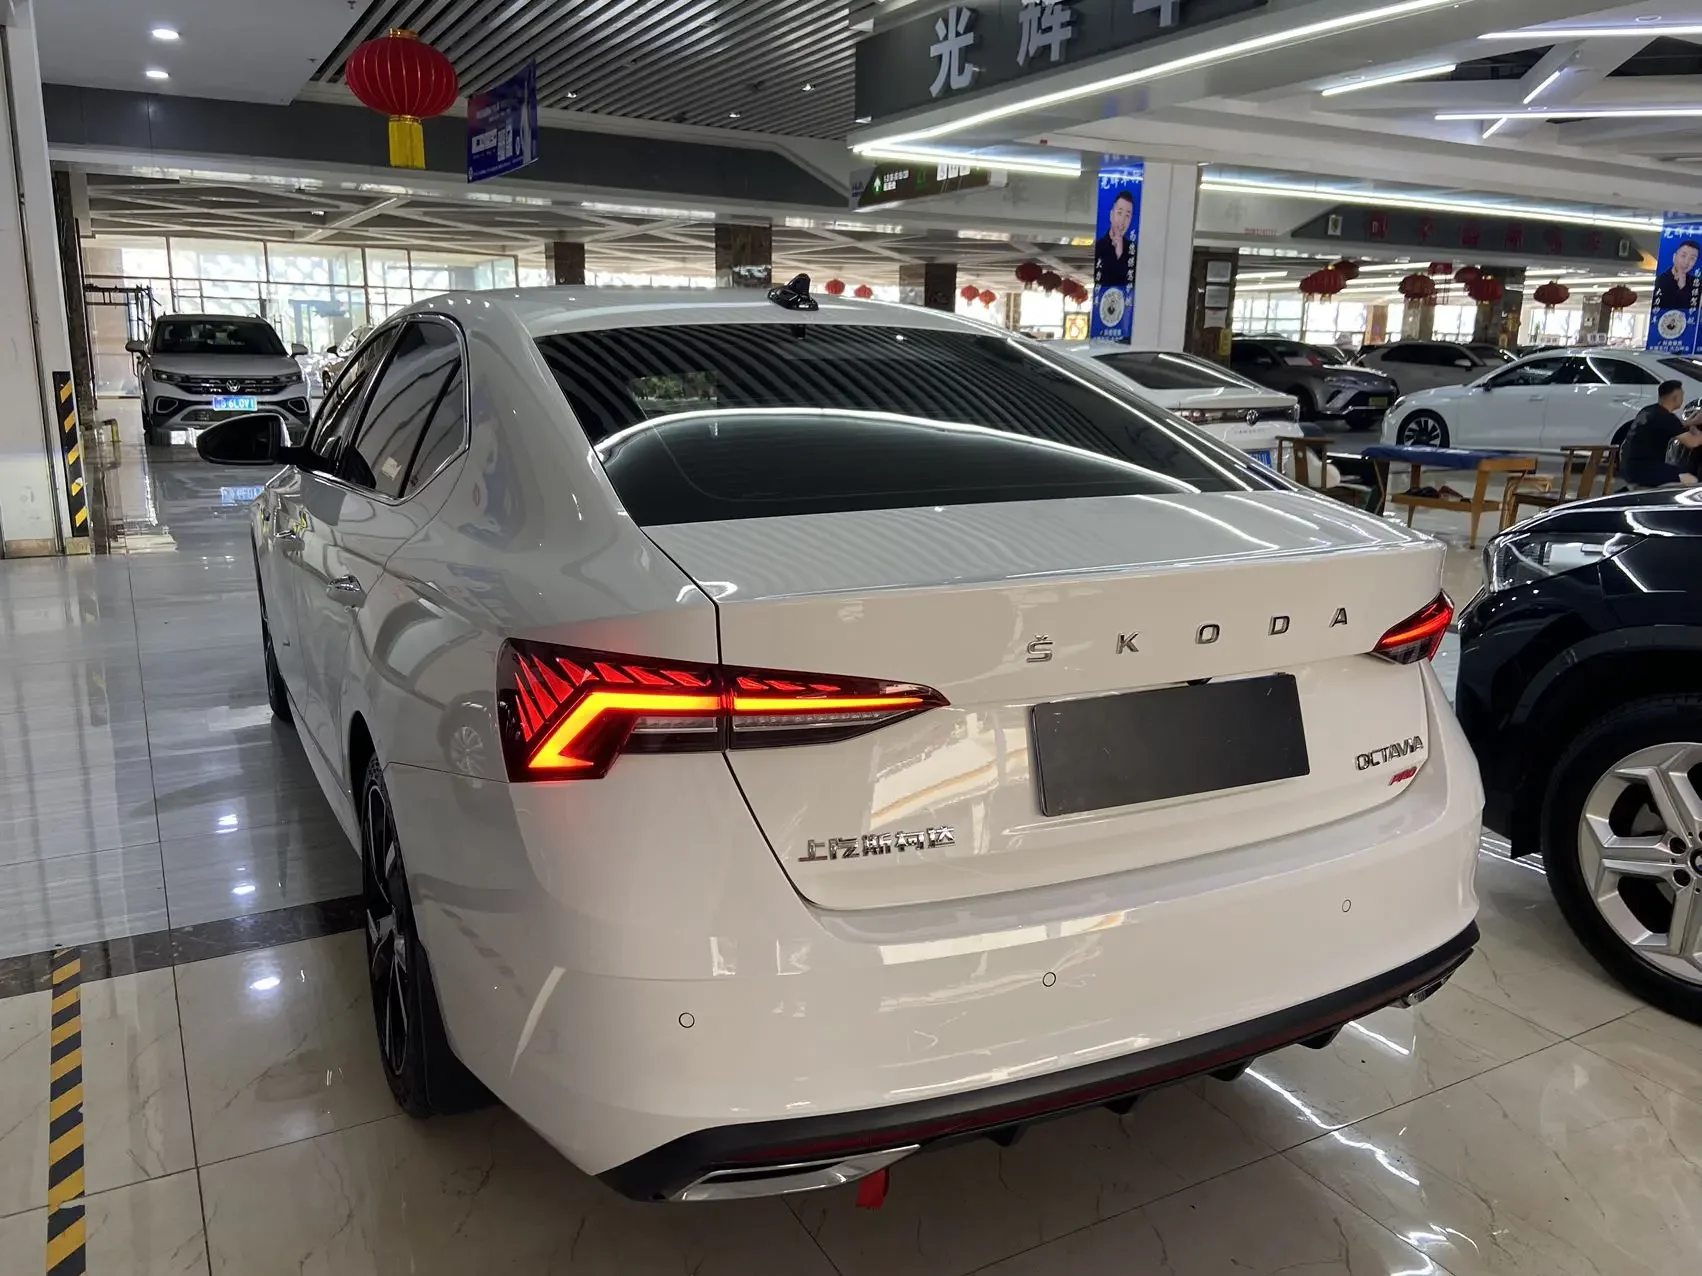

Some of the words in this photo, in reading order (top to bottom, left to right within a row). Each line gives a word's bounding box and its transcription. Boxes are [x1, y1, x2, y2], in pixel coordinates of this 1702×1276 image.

[1026, 607, 1348, 663] ŠKODA
[1355, 735, 1424, 771] OCTAVIA
[798, 825, 956, 862] 上汽斯柯达
